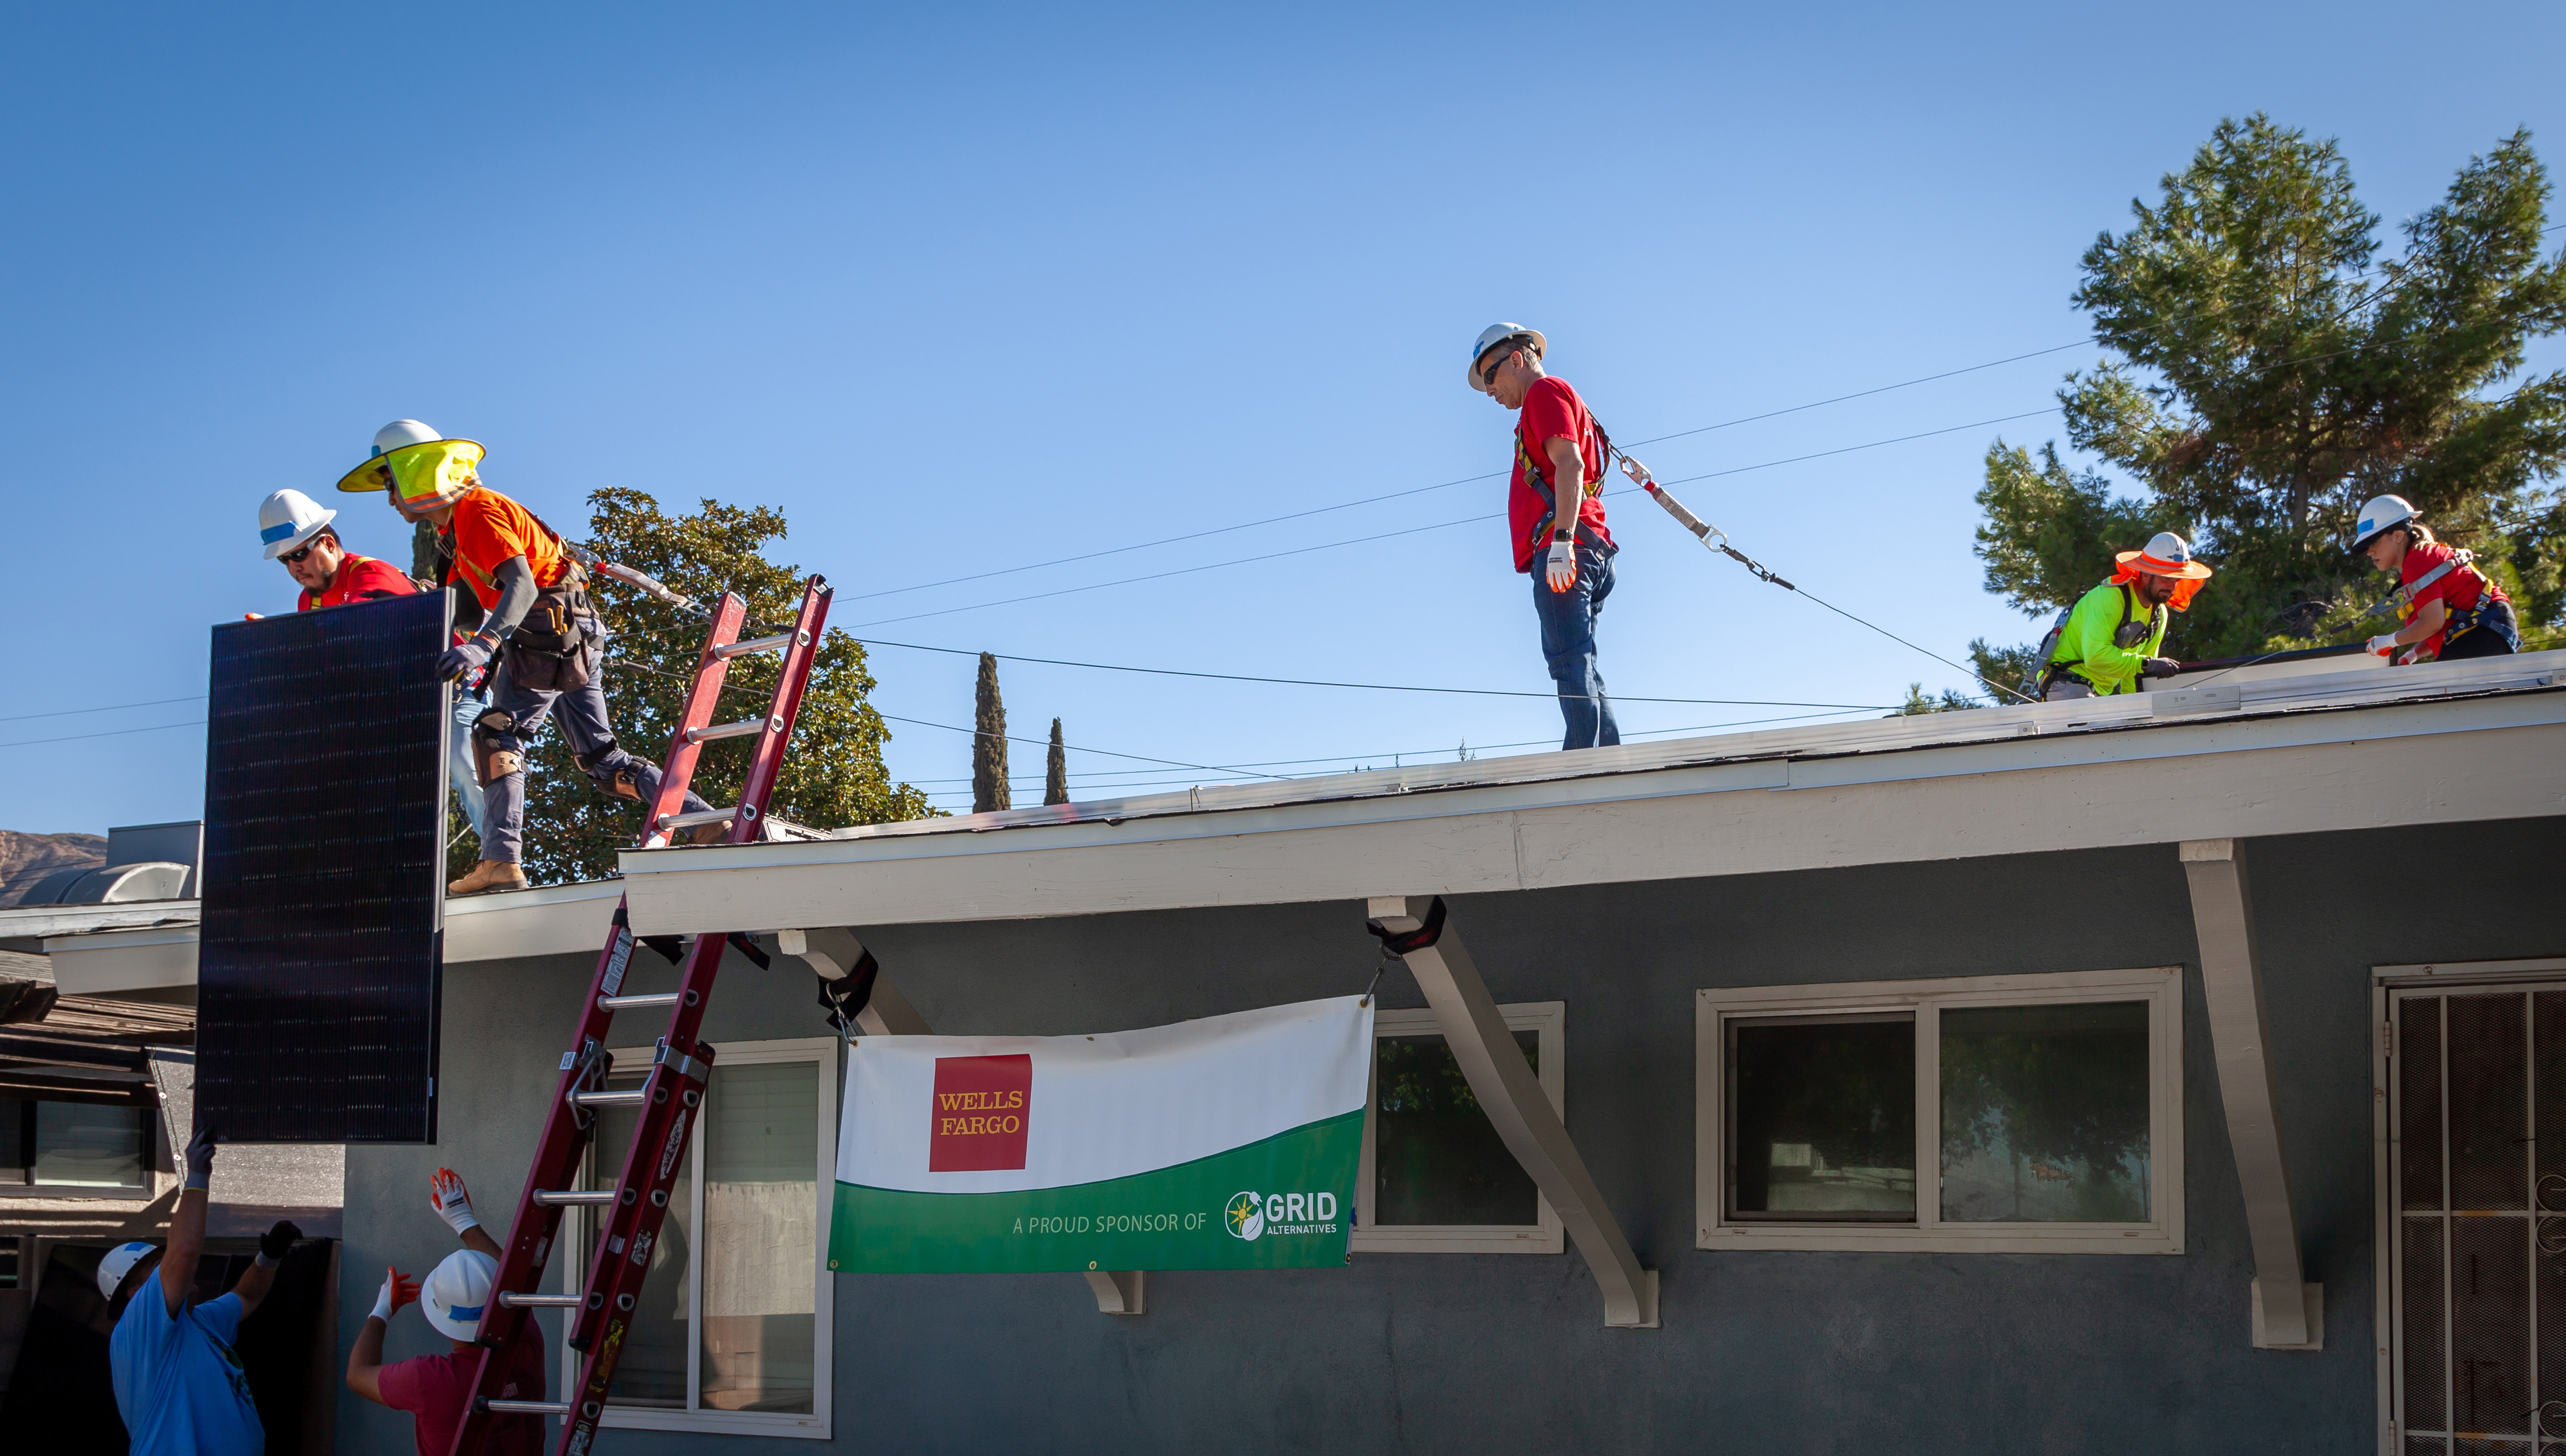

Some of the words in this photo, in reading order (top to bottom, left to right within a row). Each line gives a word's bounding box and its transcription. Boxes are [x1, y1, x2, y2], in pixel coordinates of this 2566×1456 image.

[939, 1090, 1022, 1111] WELLS
[940, 1115, 1020, 1136] FARGO
[1266, 1192, 1337, 1222] GRID
[1012, 1217, 1022, 1234] A
[1029, 1216, 1089, 1233] PROUD
[1095, 1213, 1178, 1233] SPONSOR
[1184, 1212, 1206, 1231] OF
[1267, 1224, 1337, 1235] ALTERNATIVES
